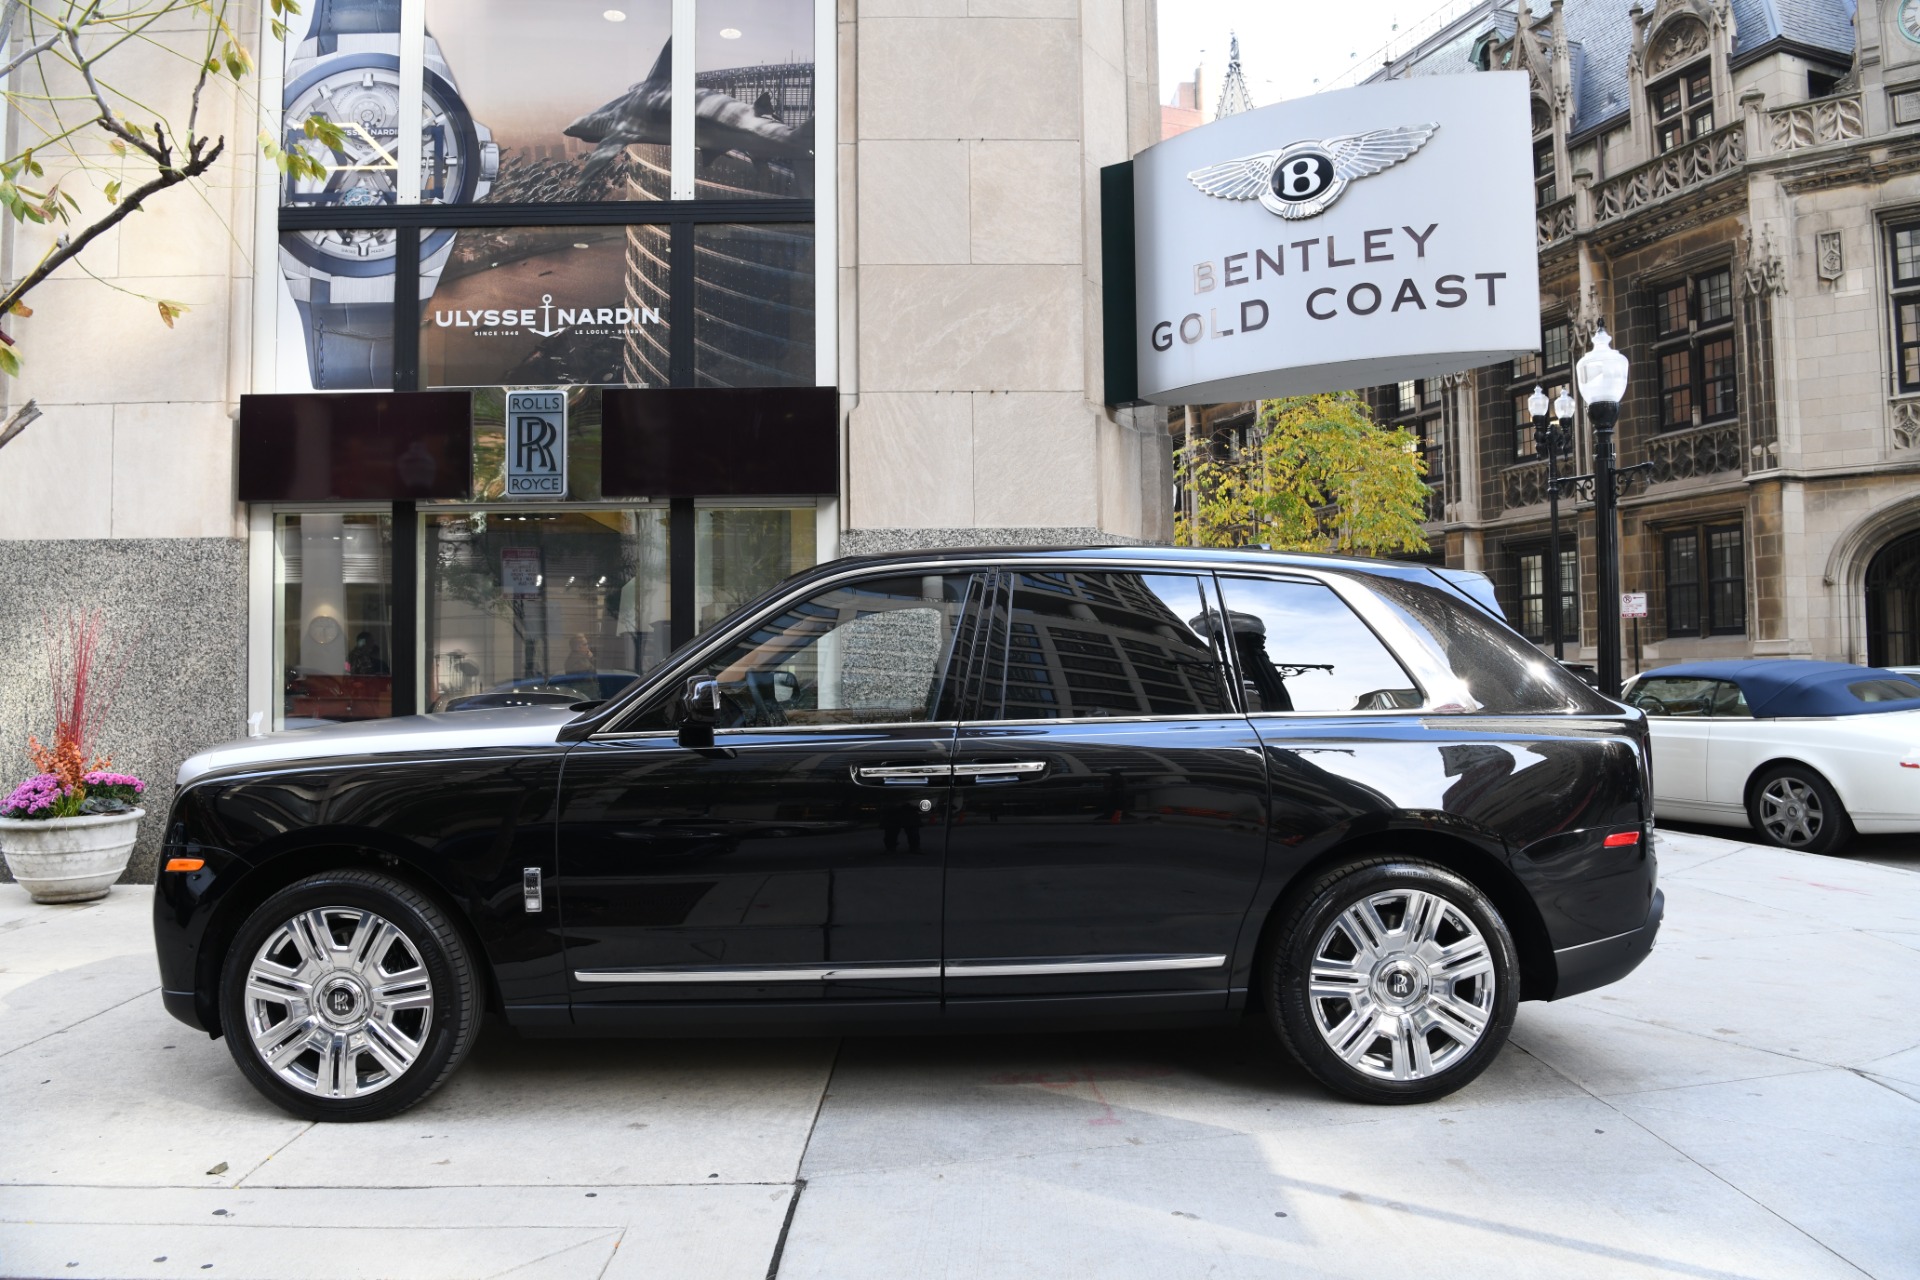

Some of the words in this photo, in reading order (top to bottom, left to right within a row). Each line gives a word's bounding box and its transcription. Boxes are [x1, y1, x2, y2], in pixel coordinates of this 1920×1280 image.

[371, 128, 398, 136] NARDI
[1280, 156, 1321, 197] B
[1192, 223, 1439, 295] BENTLEY
[435, 308, 537, 328] ULYSSE
[557, 307, 660, 326] NARDIN
[1151, 299, 1270, 352] GOLD
[1305, 271, 1507, 321] COAST
[512, 397, 560, 410] ROLLS
[511, 478, 559, 490] ROYCE
